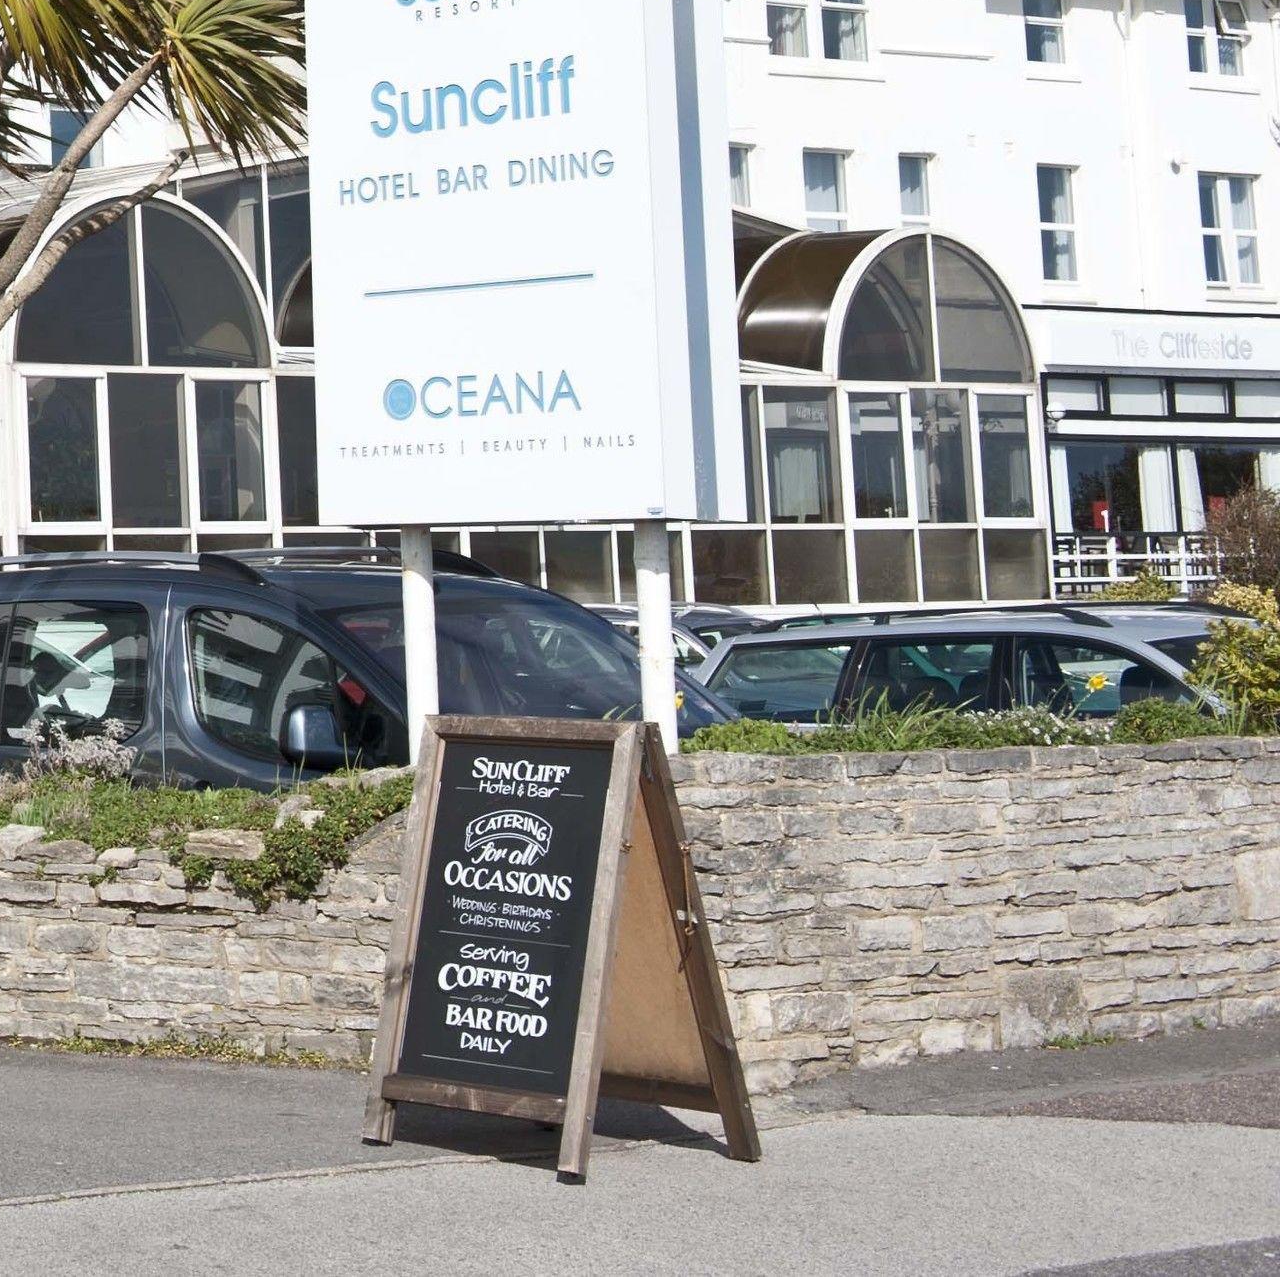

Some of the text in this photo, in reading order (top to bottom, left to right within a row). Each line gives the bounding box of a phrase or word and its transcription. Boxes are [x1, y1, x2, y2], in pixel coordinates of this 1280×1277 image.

[370, 54, 576, 139] Suncliff
[339, 149, 615, 205] HOTEL BAR DINING
[1111, 330, 1149, 358] The
[340, 434, 637, 459] TREATMENTS BEAUTY NAILS
[478, 780, 514, 795] Hotel
[527, 783, 559, 798] Bar
[474, 813, 548, 841] CATERING
[471, 842, 539, 866] for all
[443, 860, 572, 901] OCCASIONS
[452, 894, 553, 920] WEDDINGS BIRTHDAYS
[459, 913, 541, 933] CHRISTENINGS
[437, 962, 551, 1007] COFFEE
[470, 994, 506, 1005] and
[445, 1003, 548, 1037] BAR FOOD
[460, 1031, 511, 1054] DAILY
